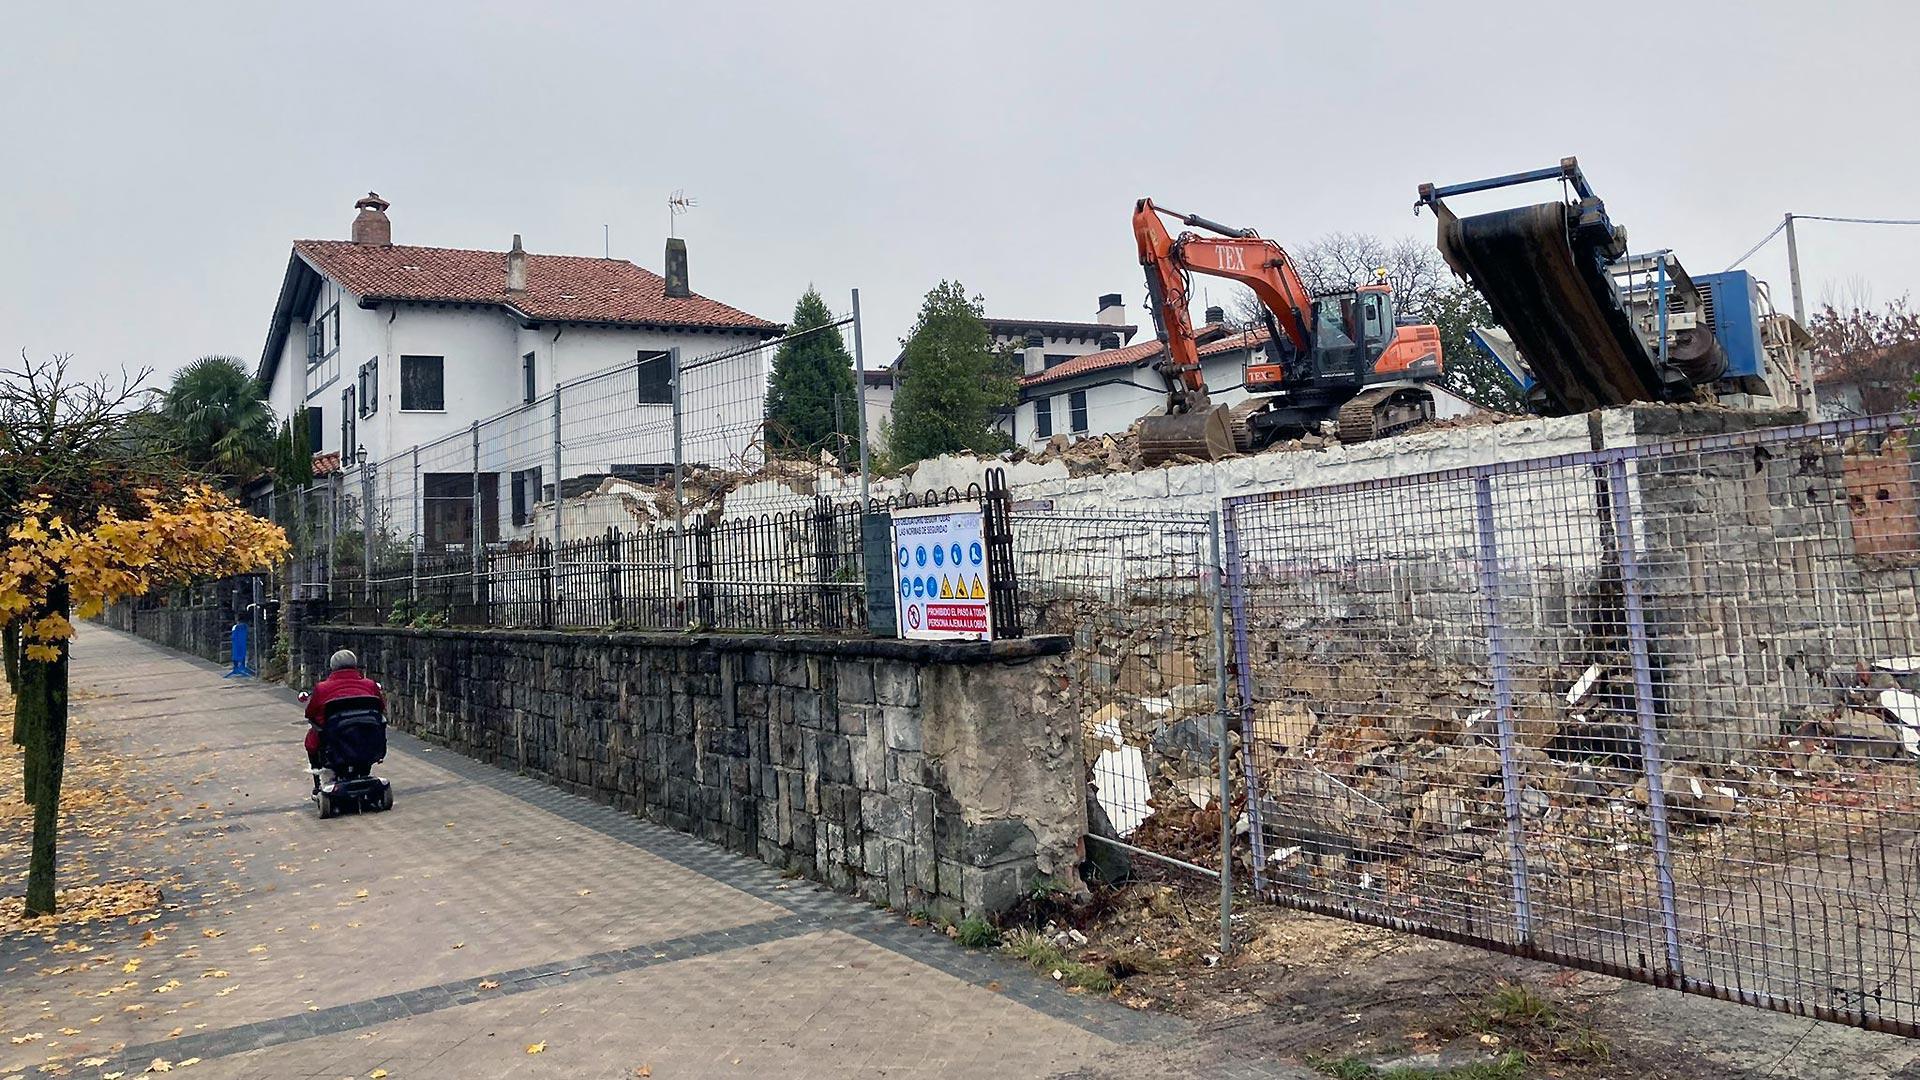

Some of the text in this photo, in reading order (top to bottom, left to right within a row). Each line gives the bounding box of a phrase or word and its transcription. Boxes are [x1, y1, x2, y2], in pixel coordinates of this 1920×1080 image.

[1215, 245, 1245, 271] TEX
[1248, 371, 1268, 381] TEX
[927, 524, 948, 534] SEGURIDAD
[927, 607, 950, 617] PROHIBIDO
[951, 607, 957, 617] EL
[957, 607, 969, 617] PASO
[973, 608, 986, 617] TODA
[928, 618, 950, 627] PERSONA
[950, 619, 963, 628] AJENA
[967, 619, 973, 628] LA
[973, 619, 987, 629] OBRA
